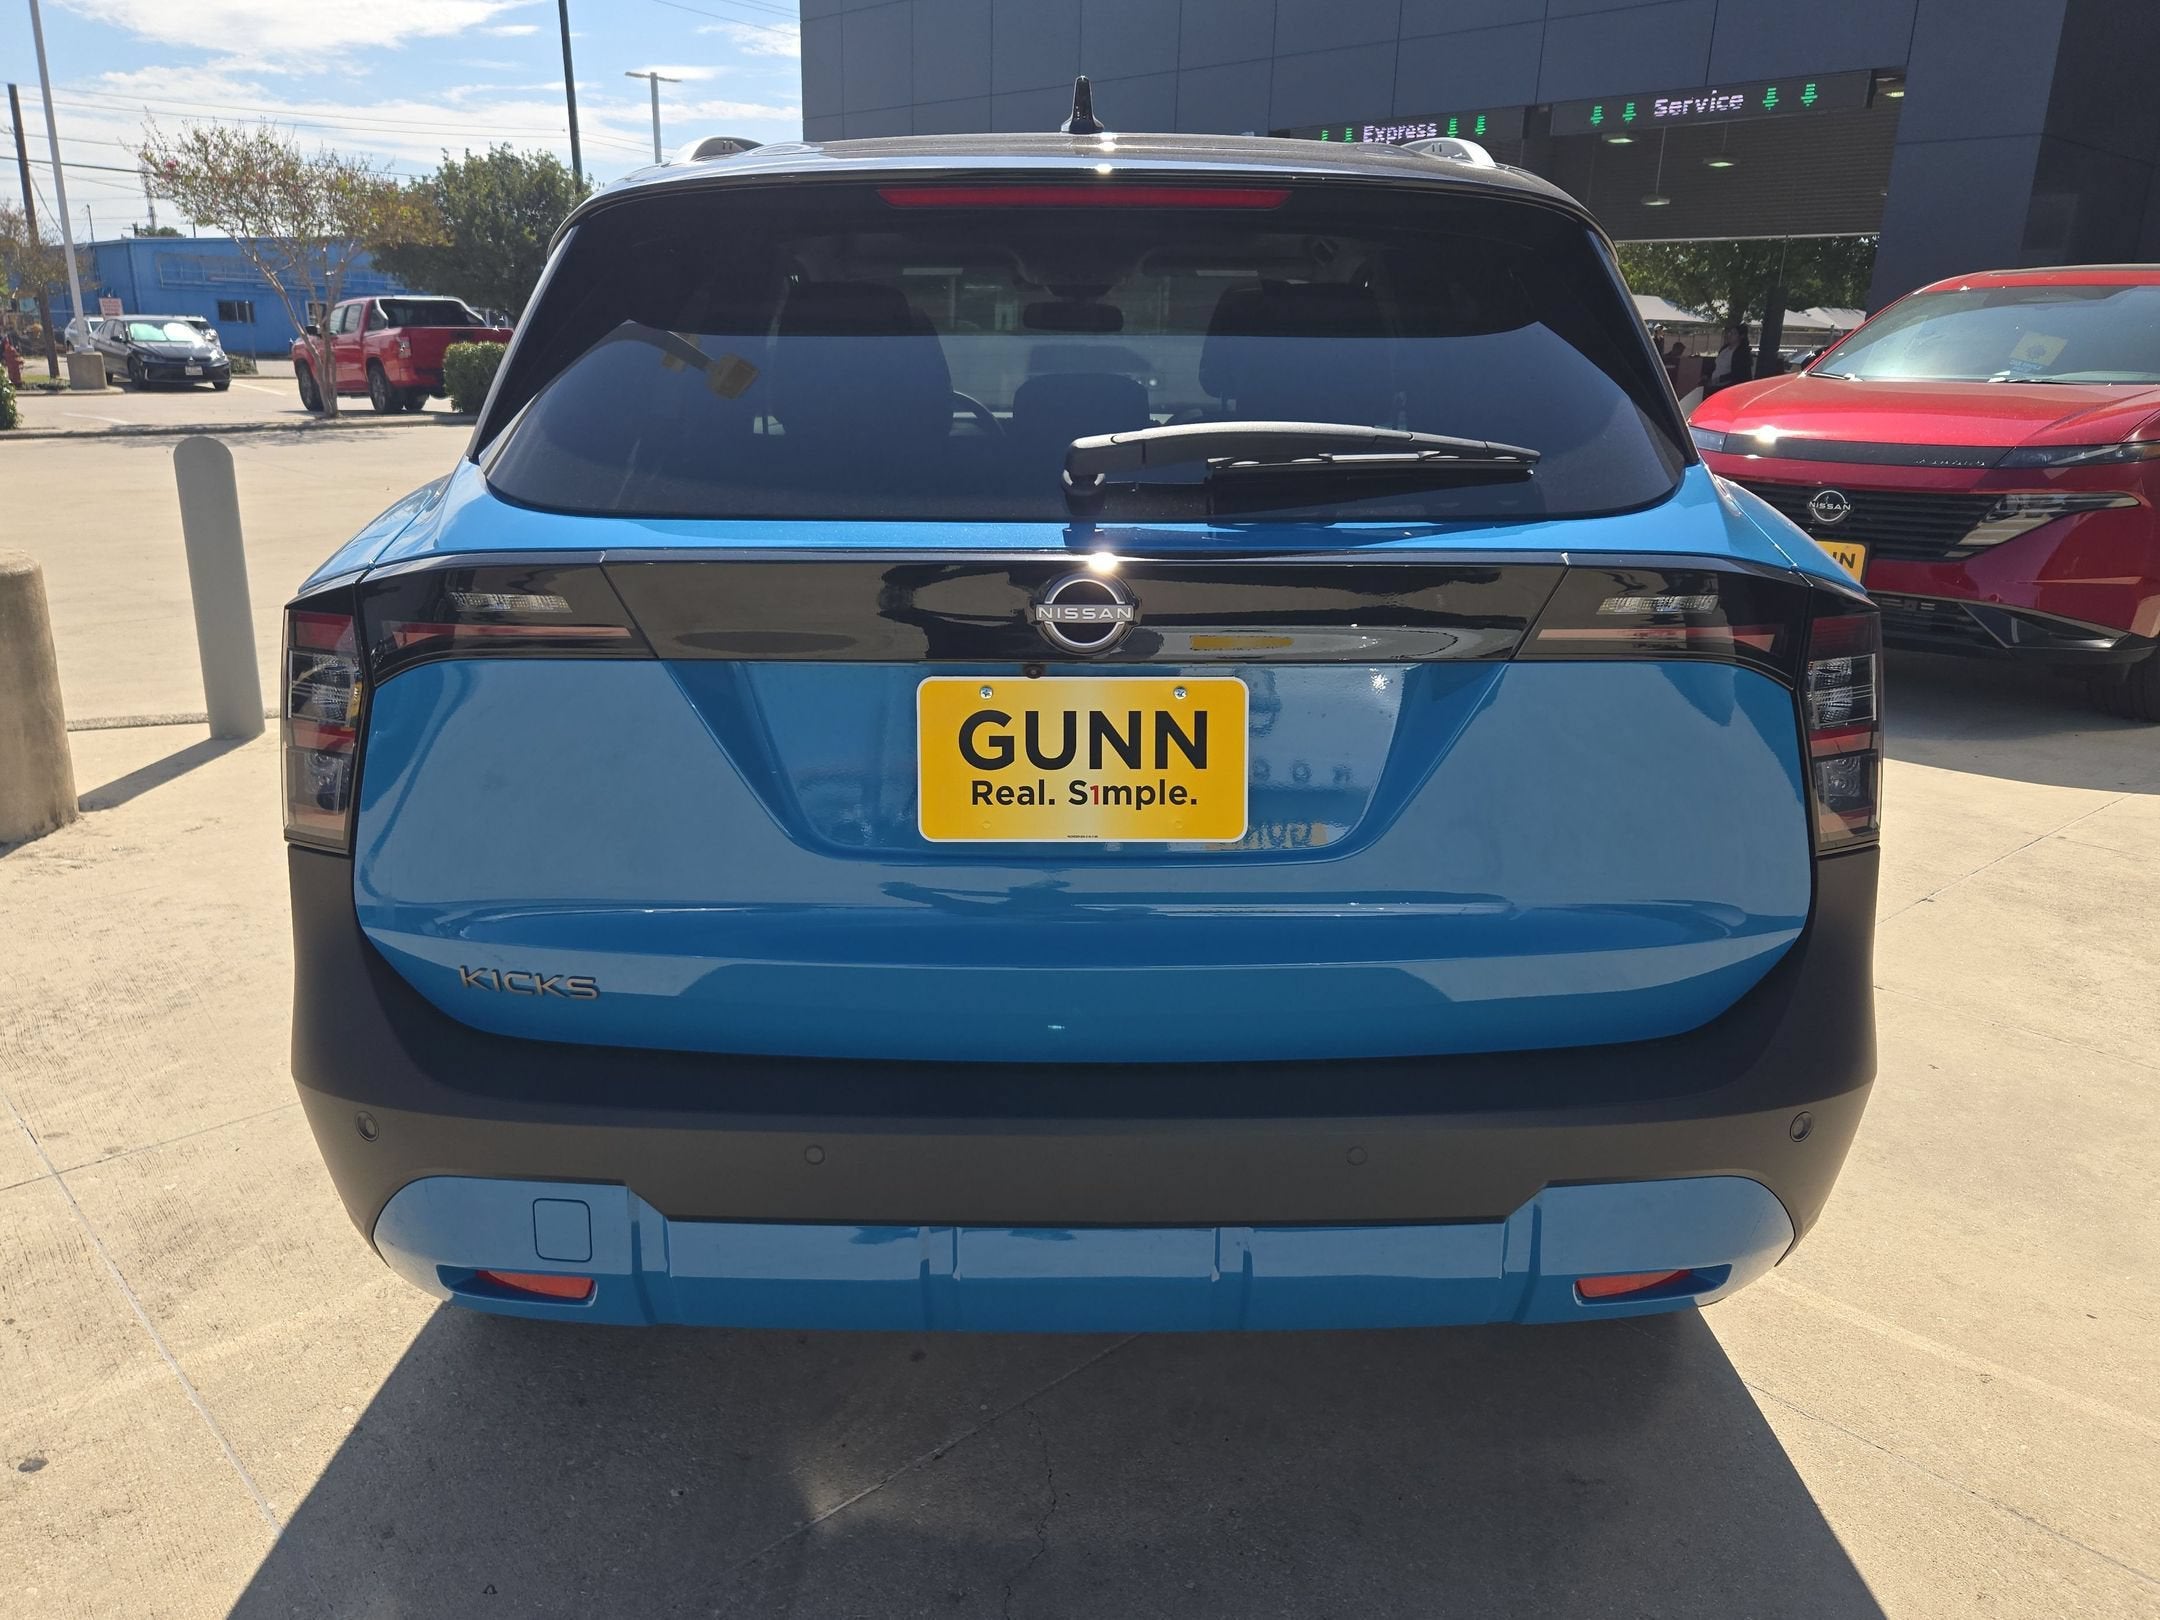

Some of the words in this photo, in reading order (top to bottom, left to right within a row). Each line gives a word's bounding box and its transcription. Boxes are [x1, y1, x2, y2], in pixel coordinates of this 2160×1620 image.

[1653, 90, 1744, 117] Service
[1362, 123, 1437, 145] Express
[1808, 501, 1851, 511] NISSAN
[1038, 607, 1132, 620] NISSAN
[958, 709, 1208, 771] GUNN
[971, 779, 1056, 806] Real.
[459, 964, 600, 1001] KICKS
